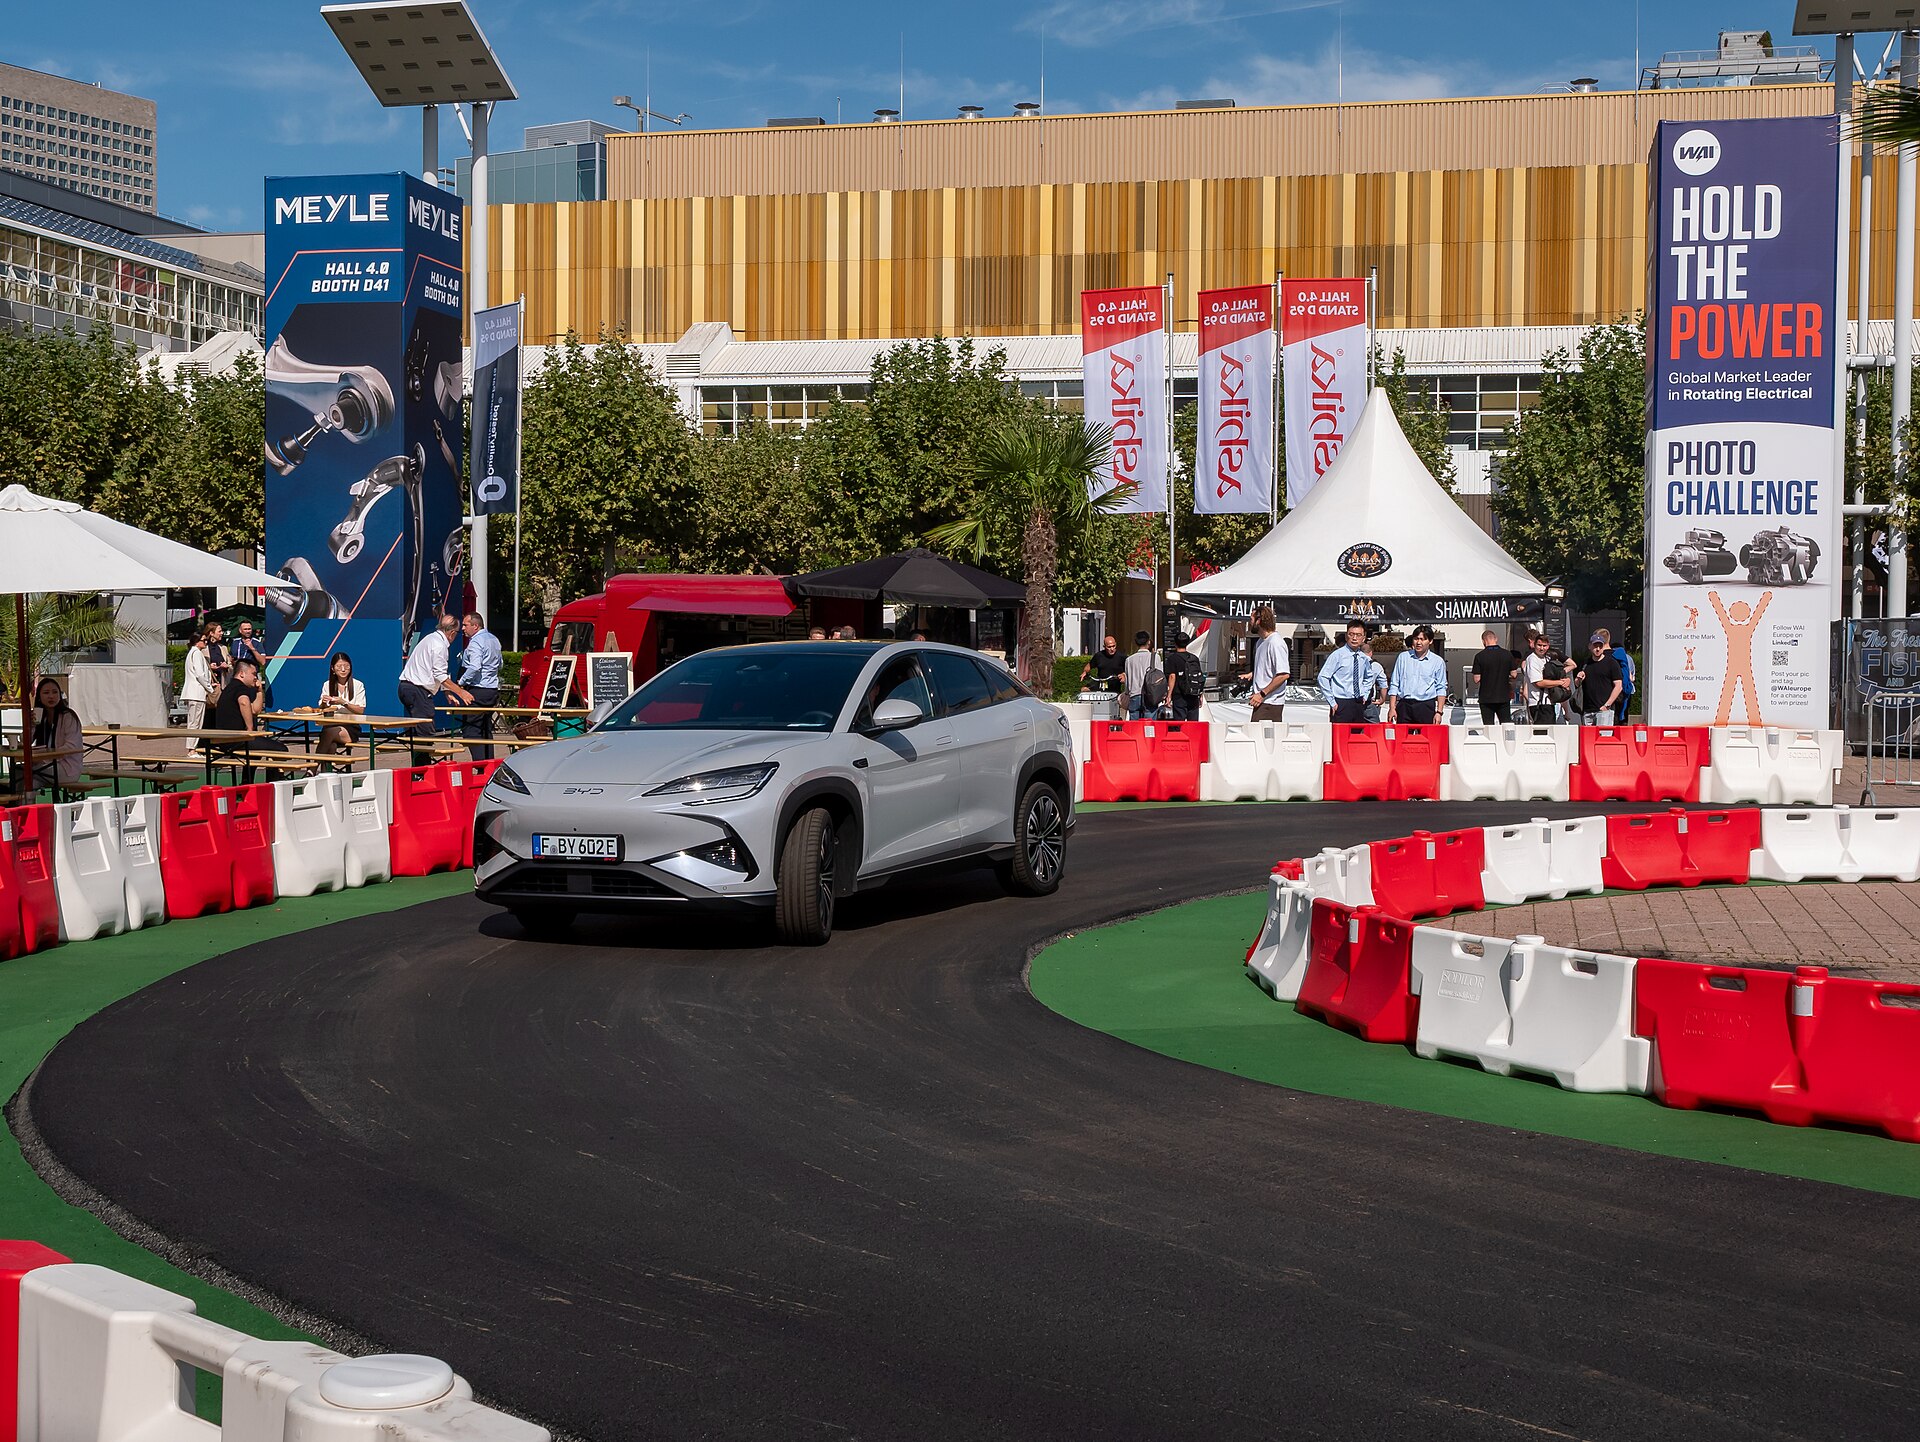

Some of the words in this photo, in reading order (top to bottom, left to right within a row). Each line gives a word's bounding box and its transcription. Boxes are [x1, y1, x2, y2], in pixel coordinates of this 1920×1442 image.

[1680, 146, 1714, 162] WAI
[275, 194, 390, 224] MEYLE
[1672, 184, 1782, 242] HOLD
[409, 196, 460, 242] MEYLE
[325, 262, 362, 276] HALL
[366, 262, 390, 275] 4.0
[1670, 244, 1748, 300] THE
[311, 280, 359, 293] BOOTH
[363, 278, 389, 292] D41
[430, 272, 448, 286] HALL
[448, 277, 459, 291] 4.0
[424, 285, 446, 303] BOOTH
[447, 293, 459, 308] D41
[1670, 302, 1823, 360] POWER
[1668, 371, 1711, 384] Global
[1714, 371, 1761, 383] Market
[1764, 370, 1812, 382] Leader
[1668, 389, 1680, 400] in
[1683, 388, 1742, 402] Rotating
[1746, 387, 1812, 399] Electrical
[1668, 440, 1756, 476] PHOTO
[1667, 480, 1818, 516] CHALLENGE
[1338, 605, 1385, 615] DIWAN
[1435, 600, 1508, 618] SHAWARMA
[1862, 629, 1887, 647] The
[1886, 678, 1905, 687] AND
[562, 787, 605, 795] BYD
[541, 838, 550, 853] F
[1442, 970, 1484, 988] SODILOR
